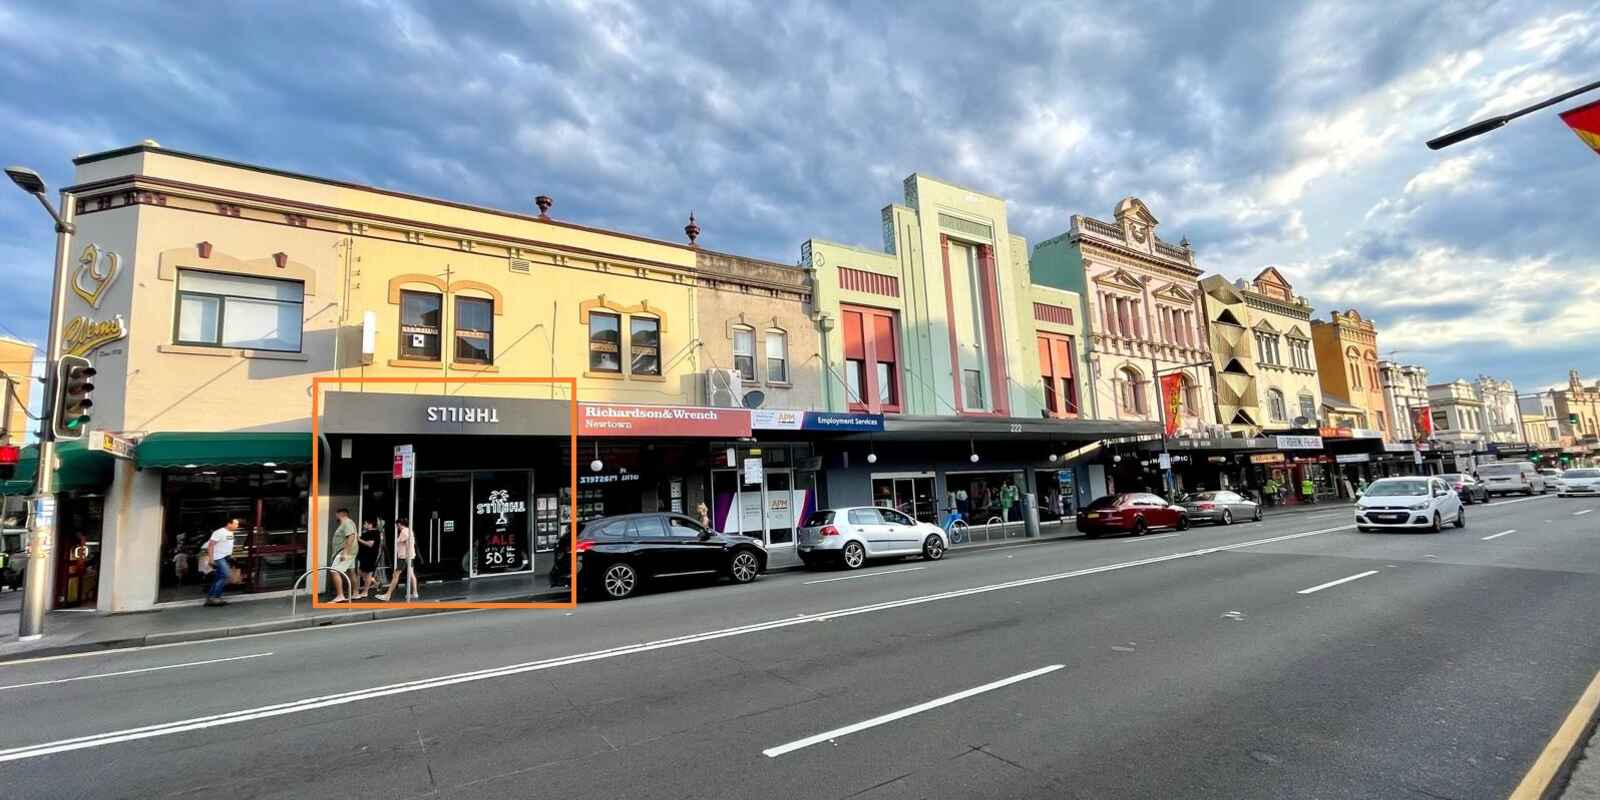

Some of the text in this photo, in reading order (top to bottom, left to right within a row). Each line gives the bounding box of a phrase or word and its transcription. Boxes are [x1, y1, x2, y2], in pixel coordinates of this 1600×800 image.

[427, 406, 499, 423] THRILLS
[585, 407, 718, 420] Richardson&Wrench
[585, 420, 632, 429] Newtown
[817, 416, 878, 426] Employment Services
[1010, 423, 1023, 433] 222
[476, 501, 526, 515] THRILLS
